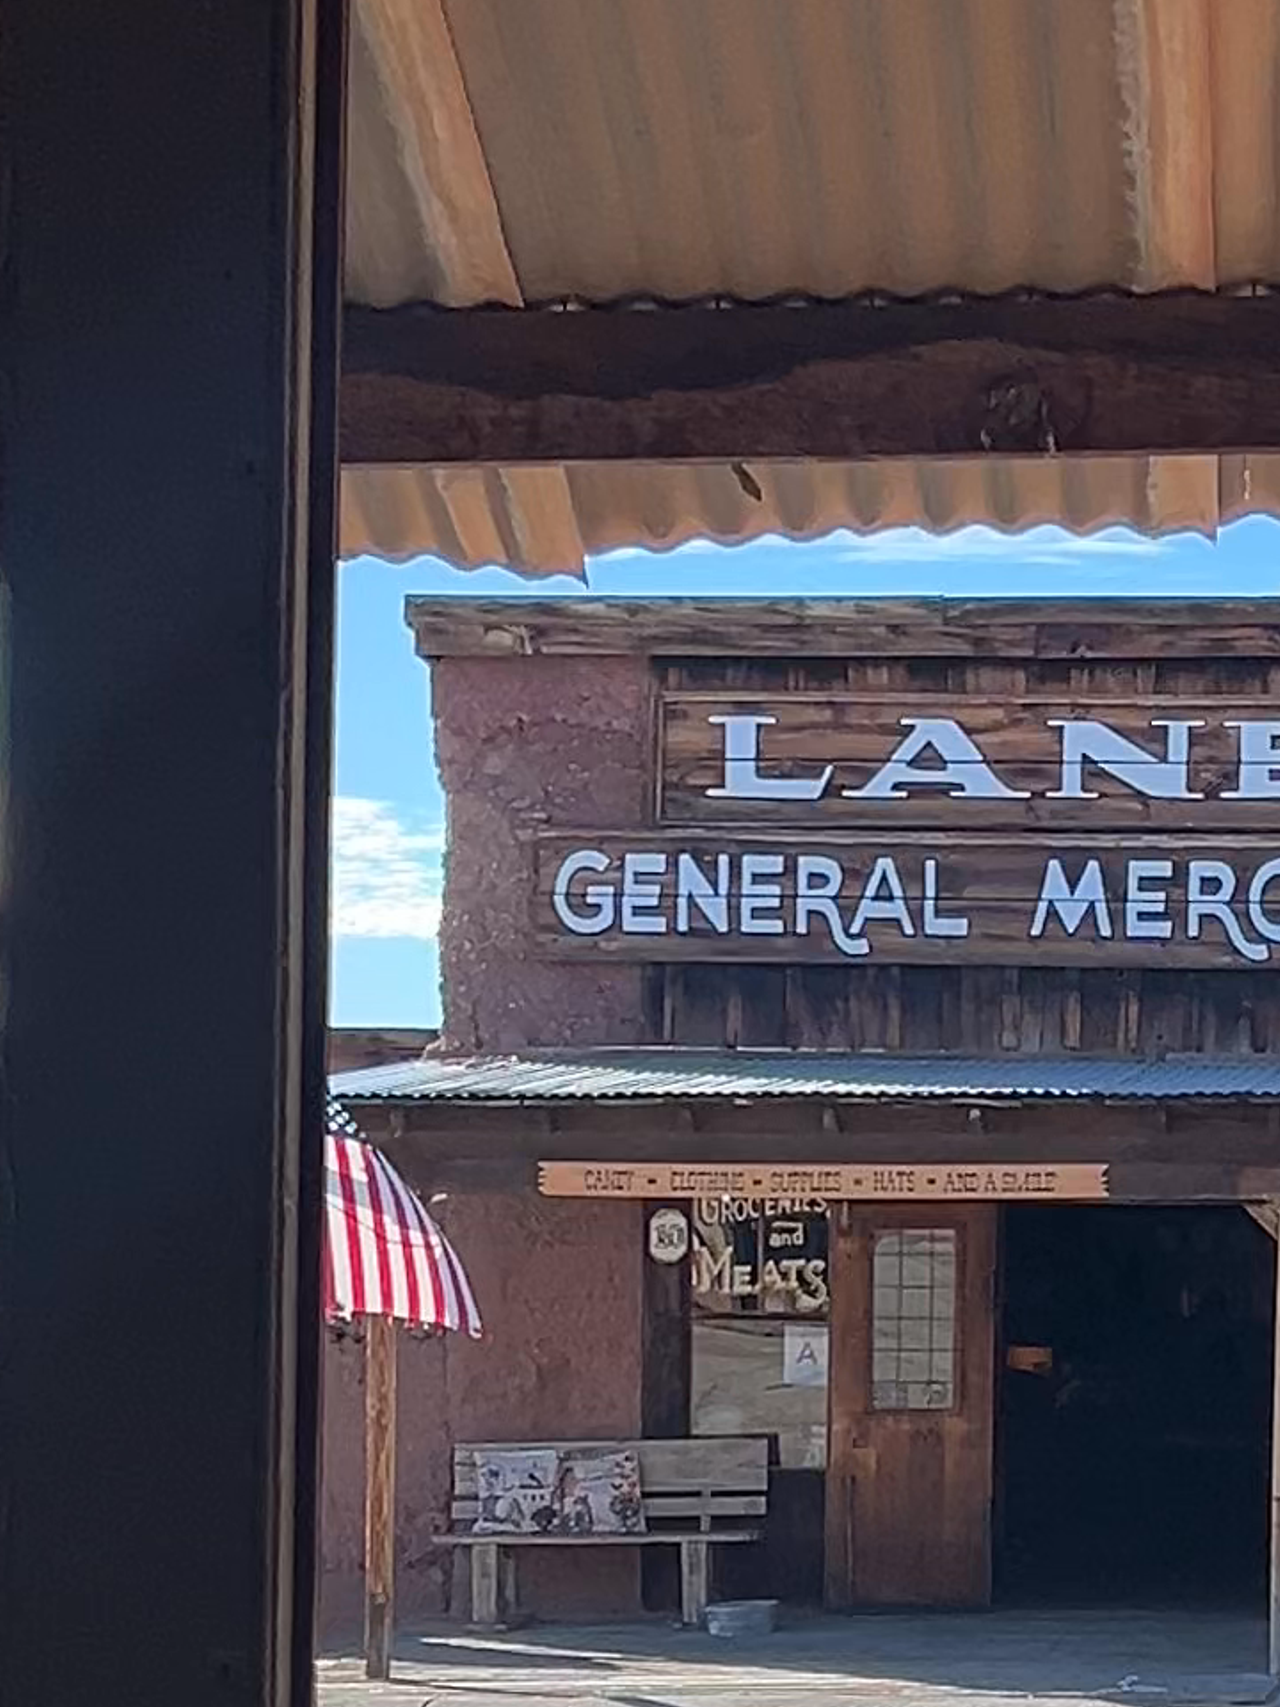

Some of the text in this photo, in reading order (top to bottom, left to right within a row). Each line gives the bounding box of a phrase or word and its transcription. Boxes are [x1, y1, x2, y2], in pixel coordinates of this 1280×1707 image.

[552, 849, 971, 955] GENERAL
[770, 1171, 842, 1192] SUPPLIES
[872, 1171, 915, 1192] HATS
[943, 1172, 978, 1192] AND
[984, 1172, 998, 1192] A
[769, 1221, 804, 1247] and
[692, 1245, 830, 1305] MEATS
[796, 1341, 818, 1365] A
